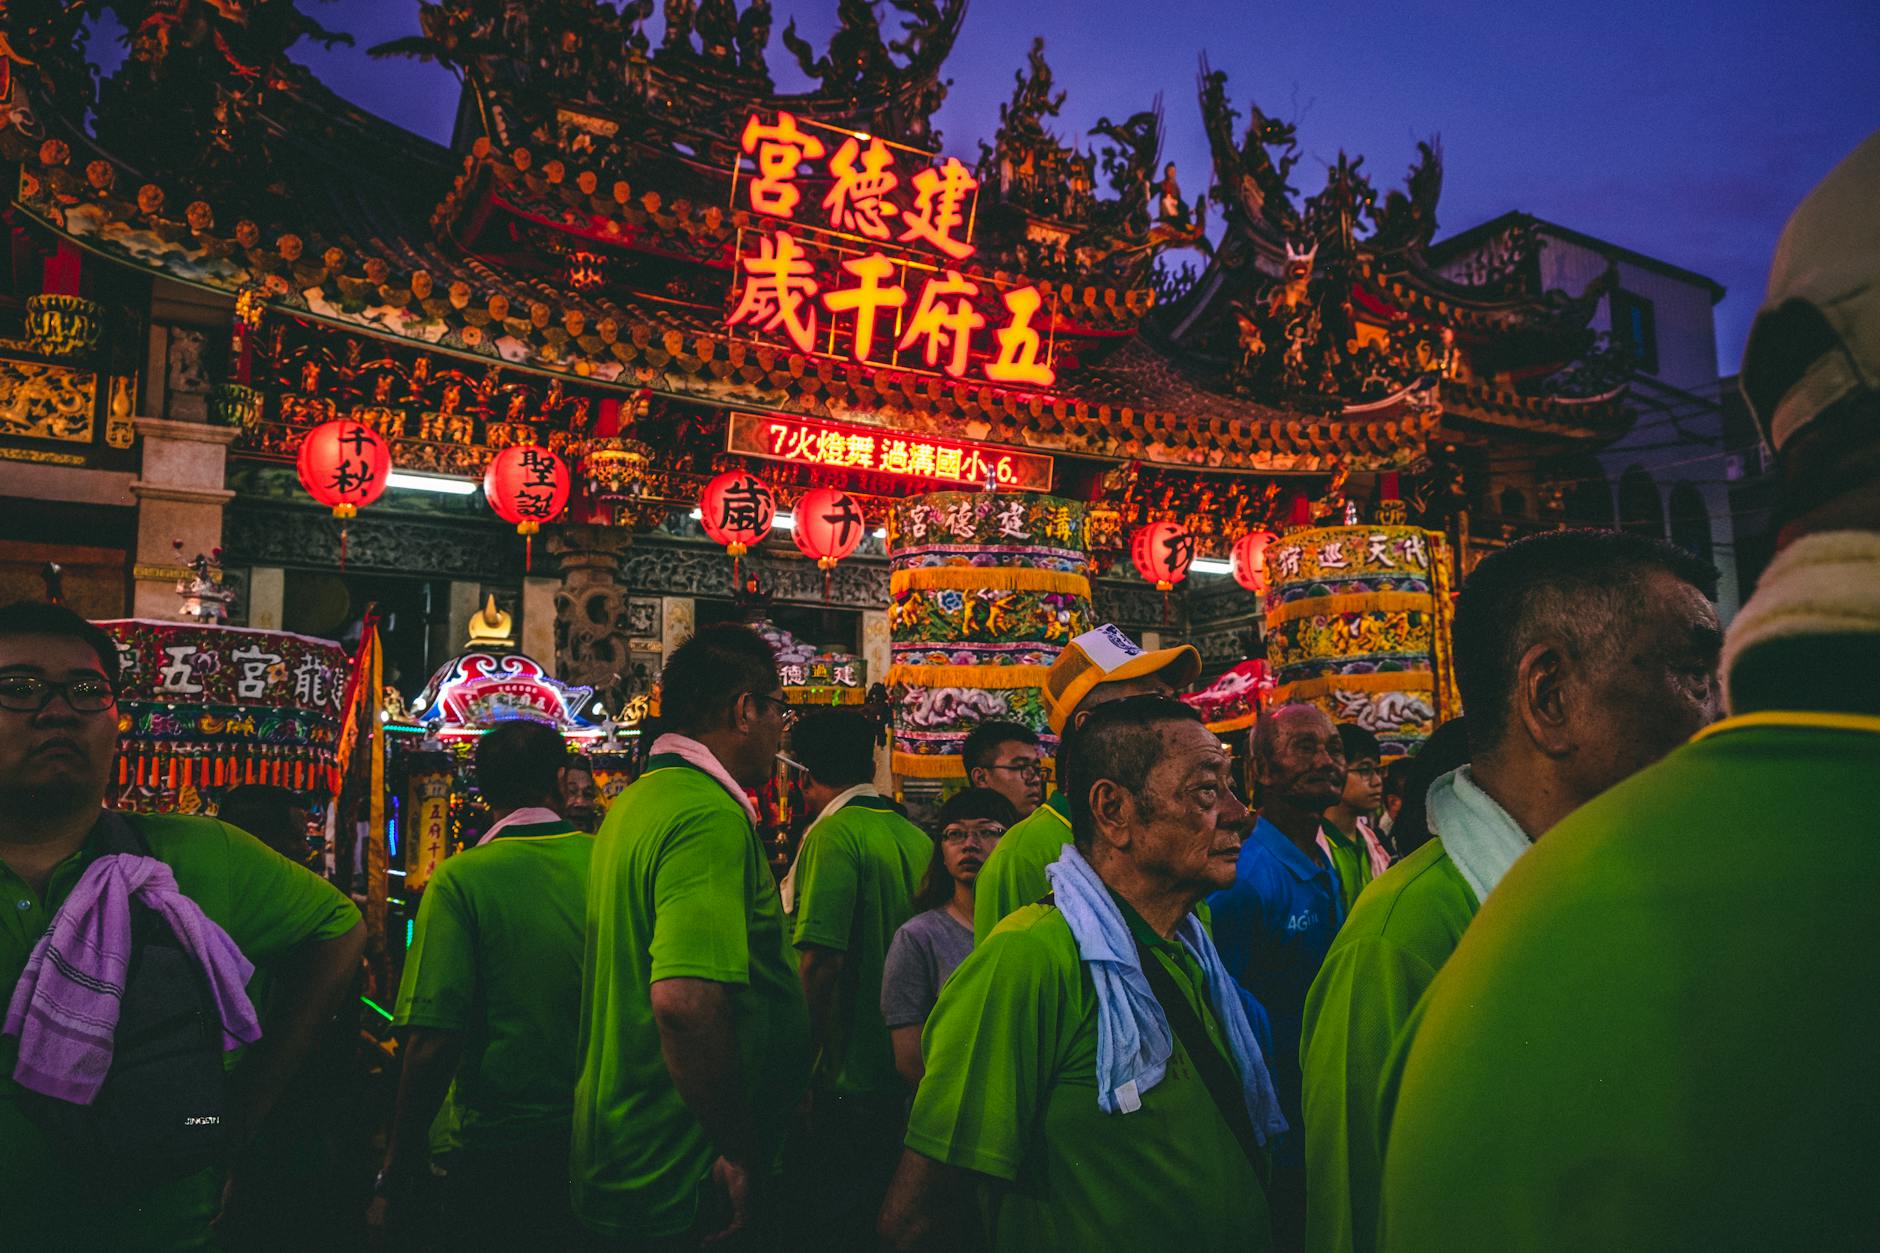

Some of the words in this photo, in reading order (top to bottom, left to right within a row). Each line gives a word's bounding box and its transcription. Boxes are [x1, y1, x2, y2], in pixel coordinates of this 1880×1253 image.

[325, 427, 376, 497] 千秋
[769, 424, 875, 468] 7火燈舞
[514, 450, 558, 518] 聖誕
[822, 497, 862, 547] 千
